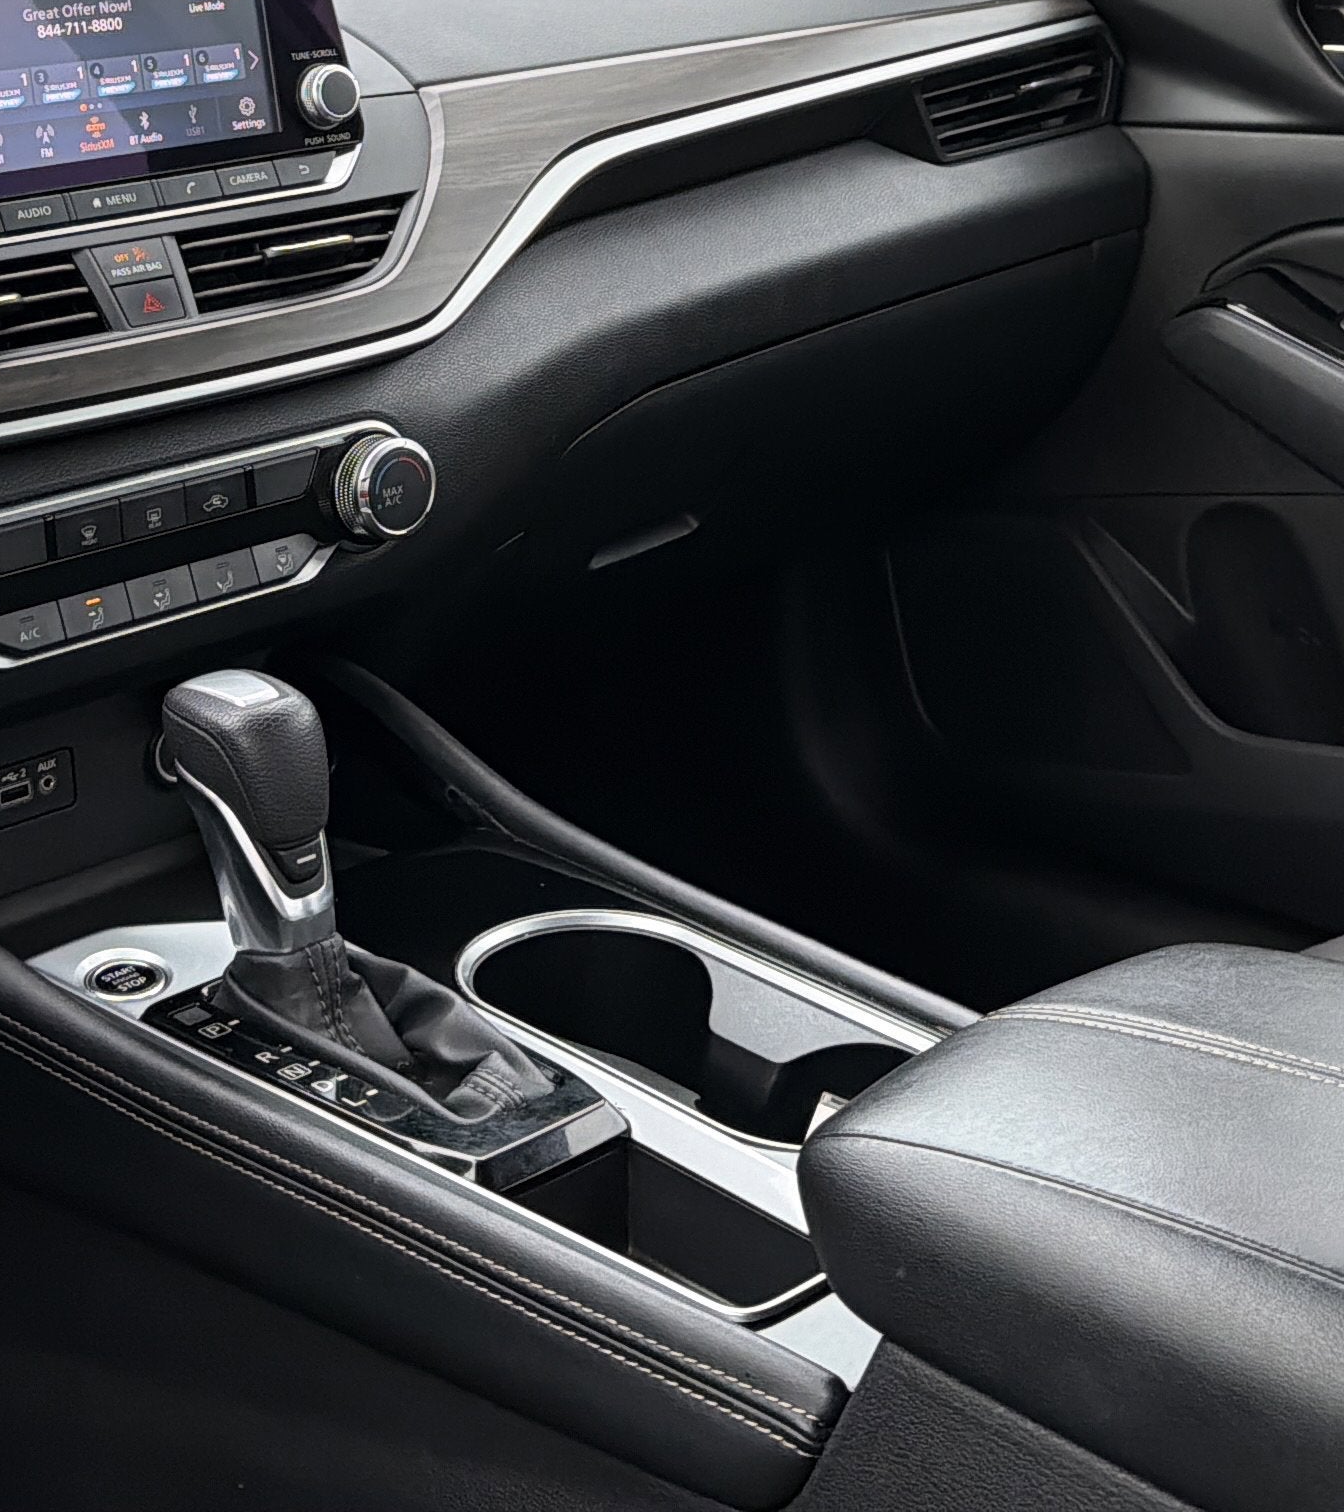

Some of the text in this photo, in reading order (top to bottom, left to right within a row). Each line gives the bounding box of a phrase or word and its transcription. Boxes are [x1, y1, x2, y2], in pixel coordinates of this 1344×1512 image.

[22, 0, 133, 22] Great Offer Now!
[36, 16, 123, 39] 844-711-8800
[186, 126, 205, 137] USB1
[232, 118, 267, 131] Settings
[80, 139, 115, 153] SiriusXM
[129, 133, 164, 145] BT Audio
[304, 132, 351, 147] PUSH SOUND
[40, 148, 54, 159] FM
[228, 170, 268, 187] CAMERA
[106, 191, 137, 206] MENU
[16, 204, 52, 220] AUDIO
[113, 252, 129, 264] OFF
[110, 266, 132, 278] PASS
[146, 261, 163, 272] BAG
[382, 484, 404, 499] MAX
[384, 494, 403, 508] A/C
[19, 626, 41, 643] A/C
[37, 757, 57, 773] AUX
[101, 965, 136, 983] START
[117, 976, 147, 992] STOP
[254, 1051, 280, 1064] R
[311, 1079, 334, 1093] D
